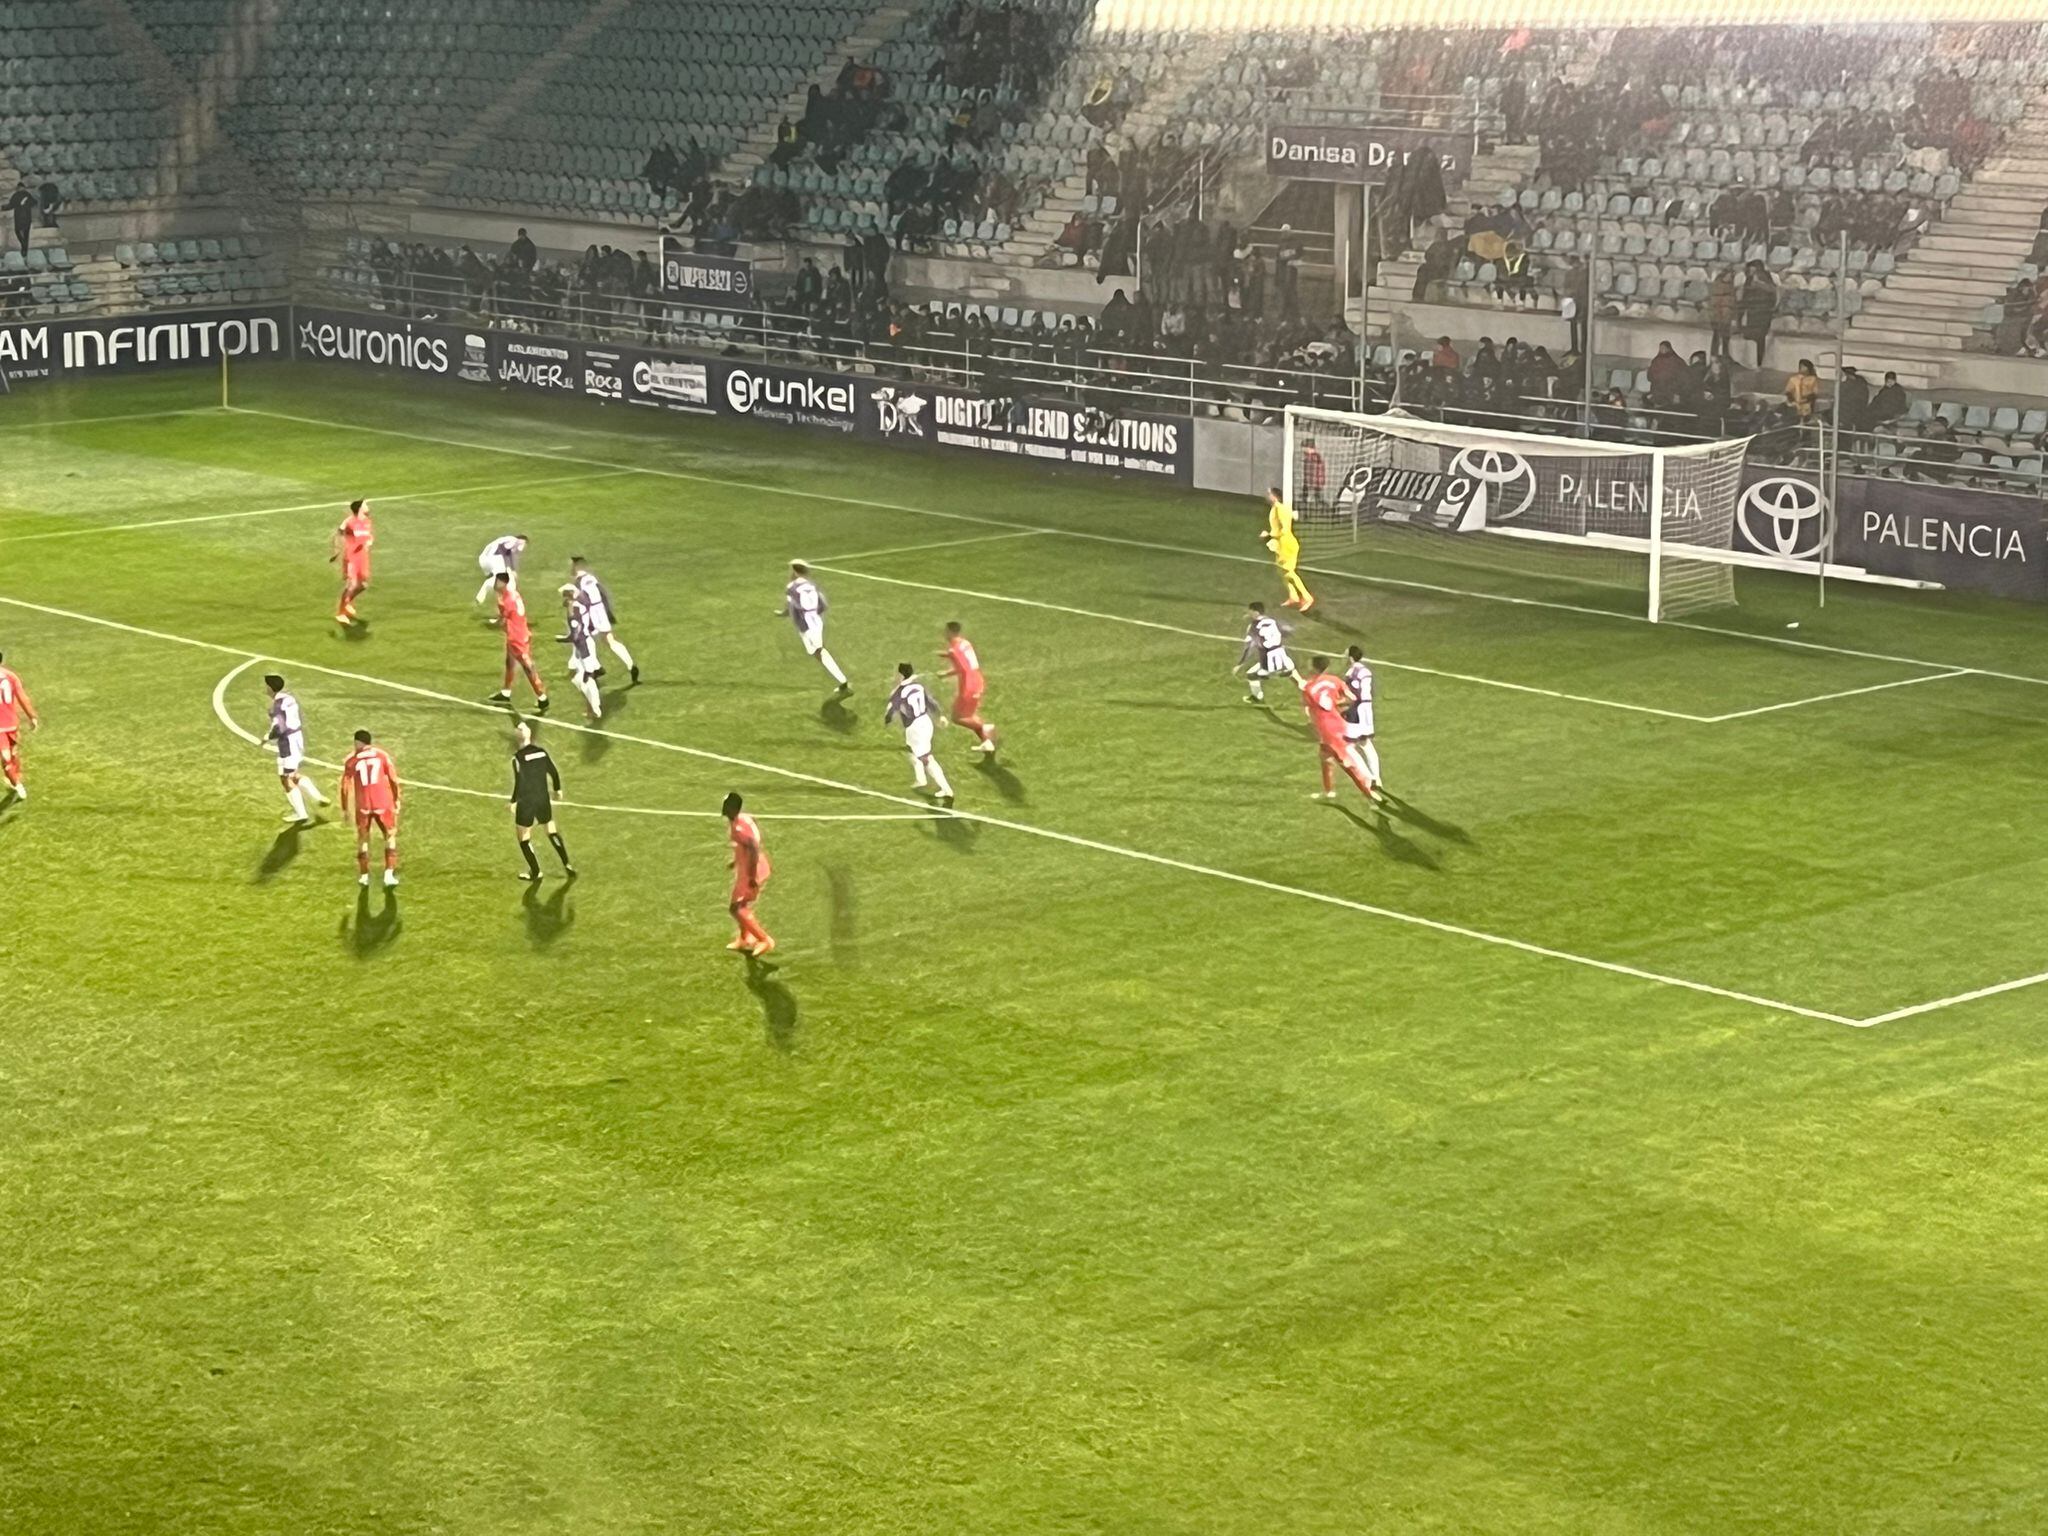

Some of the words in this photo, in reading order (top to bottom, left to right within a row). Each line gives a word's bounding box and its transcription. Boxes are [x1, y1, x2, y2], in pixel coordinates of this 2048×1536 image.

[1271, 136, 1356, 164] Danisa
[63, 317, 279, 368] INFINITON
[317, 323, 449, 373] euronics
[498, 359, 564, 388] JAVIER
[585, 369, 622, 391] Roca
[727, 369, 855, 414] grunkel
[1863, 510, 2027, 563] PALENCIA
[355, 757, 380, 787] 17
